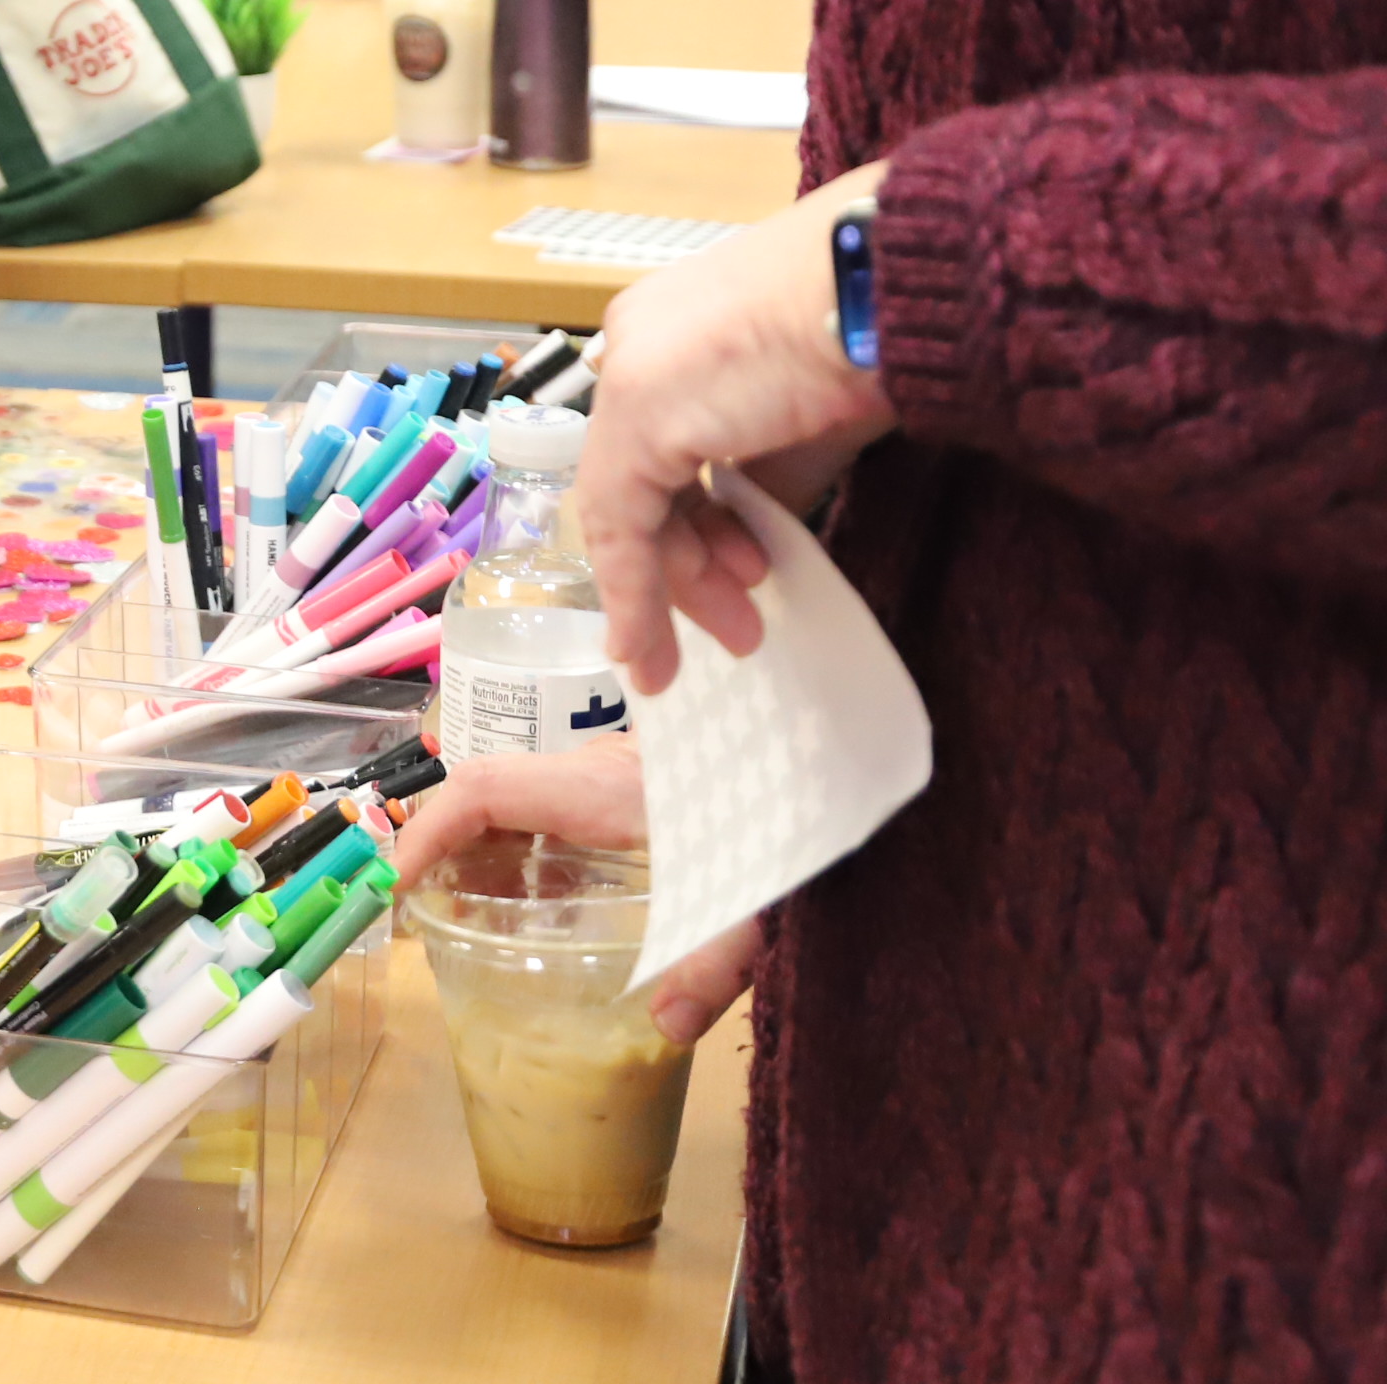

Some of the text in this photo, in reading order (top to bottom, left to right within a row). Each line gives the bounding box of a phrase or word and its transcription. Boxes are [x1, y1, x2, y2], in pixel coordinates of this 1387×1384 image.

[65, 38, 133, 85] JOE'S
[472, 685, 537, 708] Nutrition Facts
[510, 682, 528, 692] juice
[472, 717, 536, 735] Calories 0
